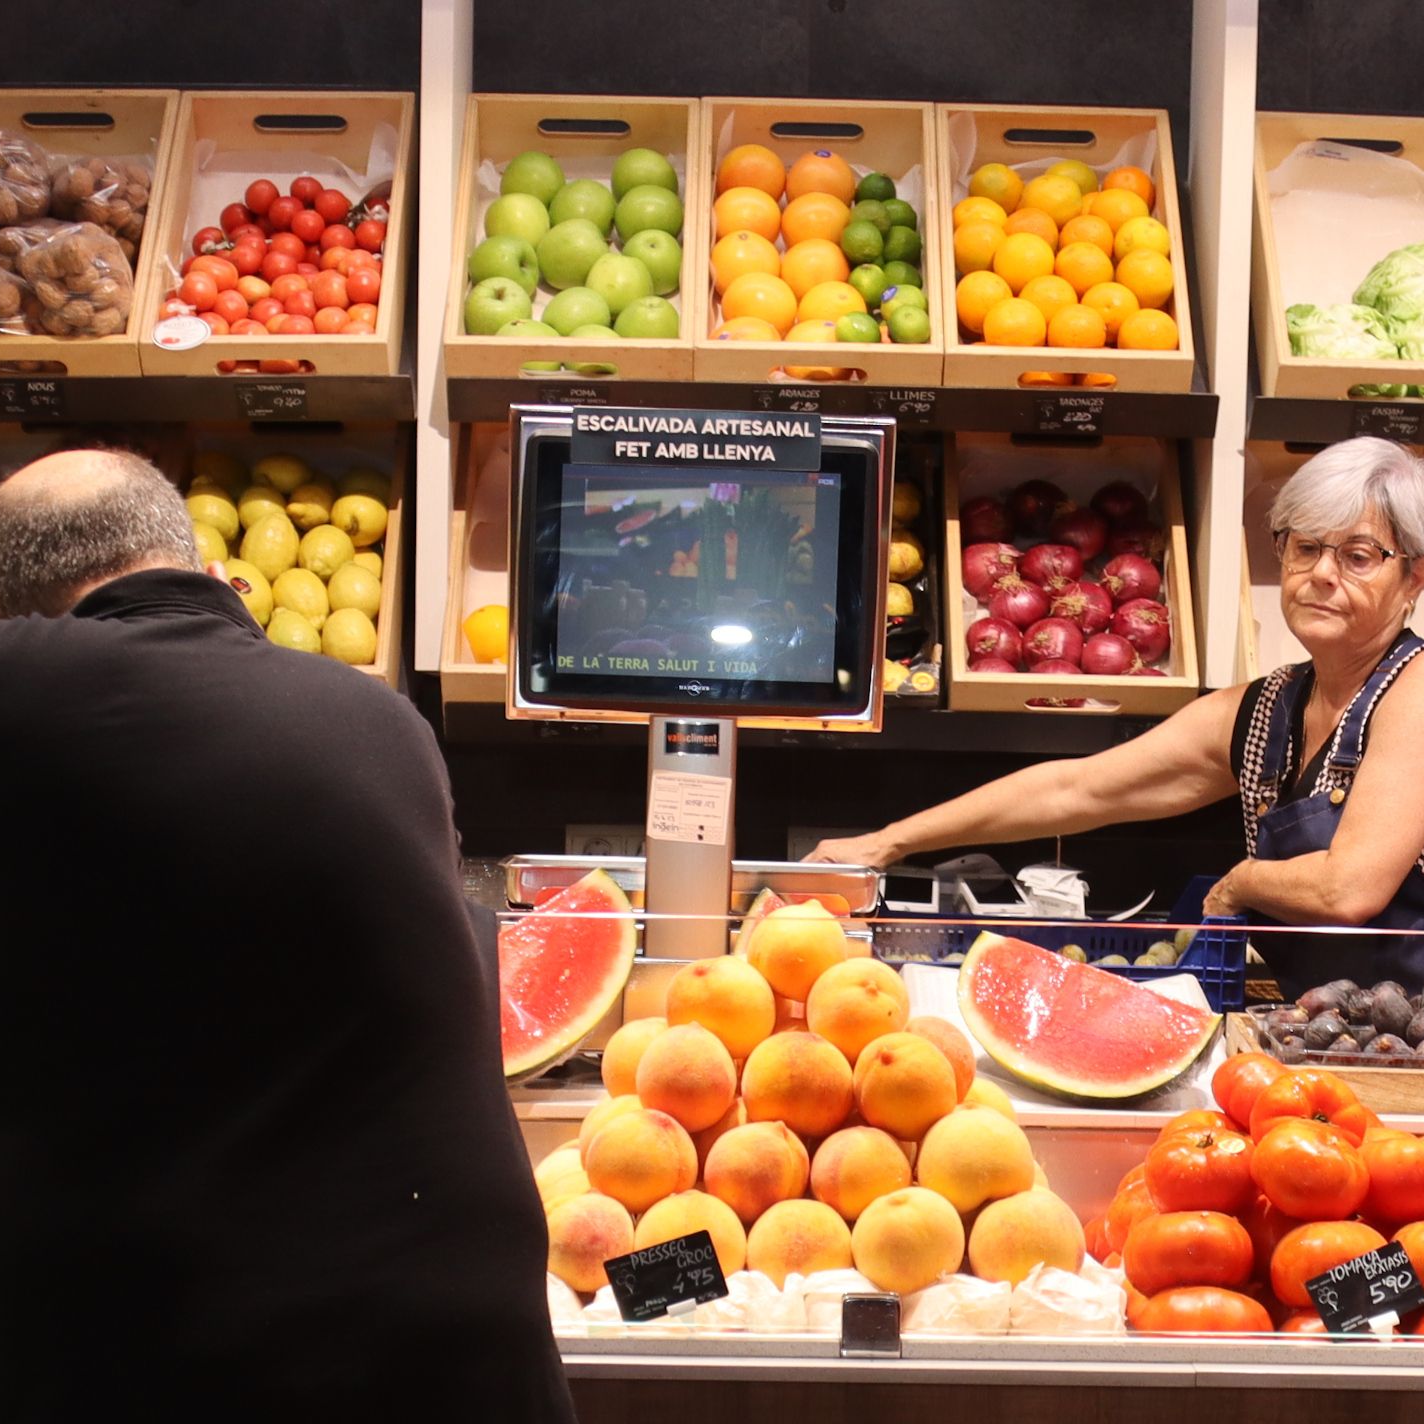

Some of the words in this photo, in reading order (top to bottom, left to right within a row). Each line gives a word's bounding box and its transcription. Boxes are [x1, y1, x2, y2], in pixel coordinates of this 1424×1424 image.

[570, 389, 596, 397] POMA
[889, 391, 935, 401] LLIMES
[577, 415, 697, 434] ESCALIVADA
[701, 418, 815, 438] ARTESANAL
[615, 441, 651, 457] FET
[655, 443, 698, 459] AMB
[703, 444, 776, 461] LLENYA
[557, 655, 574, 668] DE
[583, 656, 600, 669] LA
[608, 657, 649, 670] TERRA
[657, 659, 699, 672] SALUT
[707, 660, 715, 673] I
[725, 661, 757, 673] VIDA
[630, 1239, 687, 1270] PRESSEC
[676, 1245, 712, 1268] GROC
[1328, 1250, 1380, 1283] TOMACA
[1370, 1270, 1412, 1304] 5'90
